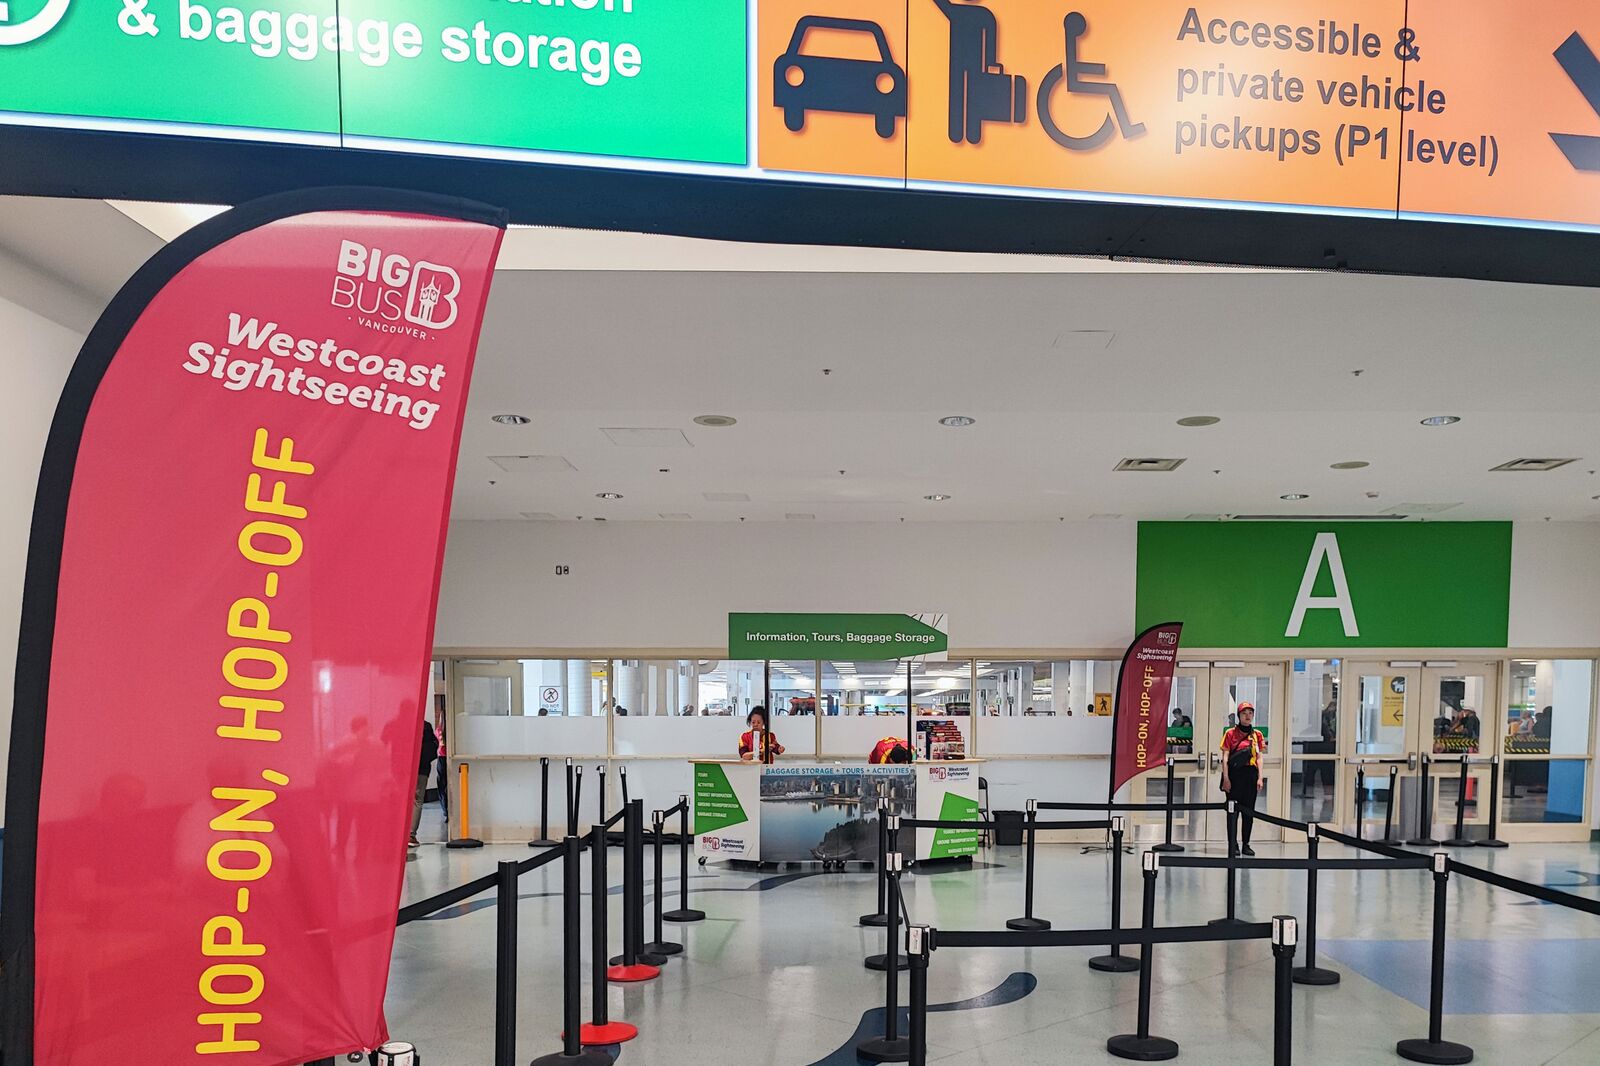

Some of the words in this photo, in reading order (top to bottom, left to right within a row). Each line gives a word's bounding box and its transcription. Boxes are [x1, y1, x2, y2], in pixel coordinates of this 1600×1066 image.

[117, 0, 159, 37] &
[179, 0, 423, 66] baggage
[441, 19, 643, 87] storage
[1176, 7, 1382, 59] Accessible
[1394, 28, 1421, 63] &
[1177, 62, 1304, 103] private
[1316, 75, 1446, 115] vehicle
[1175, 114, 1321, 162] pickups
[1334, 123, 1389, 165] (P1
[1406, 130, 1499, 177] level)
[336, 239, 411, 287] BIG
[330, 275, 403, 321] BUS
[227, 312, 446, 392] Westcoast
[357, 316, 428, 340] VANCOUVER
[182, 341, 440, 430] Sightseeing
[216, 428, 315, 742] HOP-OFF
[1284, 532, 1360, 638] A
[746, 632, 809, 642] Information,
[811, 632, 843, 642] Tours,
[846, 632, 892, 644] Baggage
[894, 632, 935, 644] Storage
[1137, 652, 1173, 662] Sightseeing
[1142, 647, 1174, 656] Westcoast
[1140, 664, 1154, 716] HOP-OFF
[1137, 719, 1150, 768] HOP-ON,
[765, 767, 800, 775] BAGGAGE
[195, 769, 289, 1054] HOP-ON,
